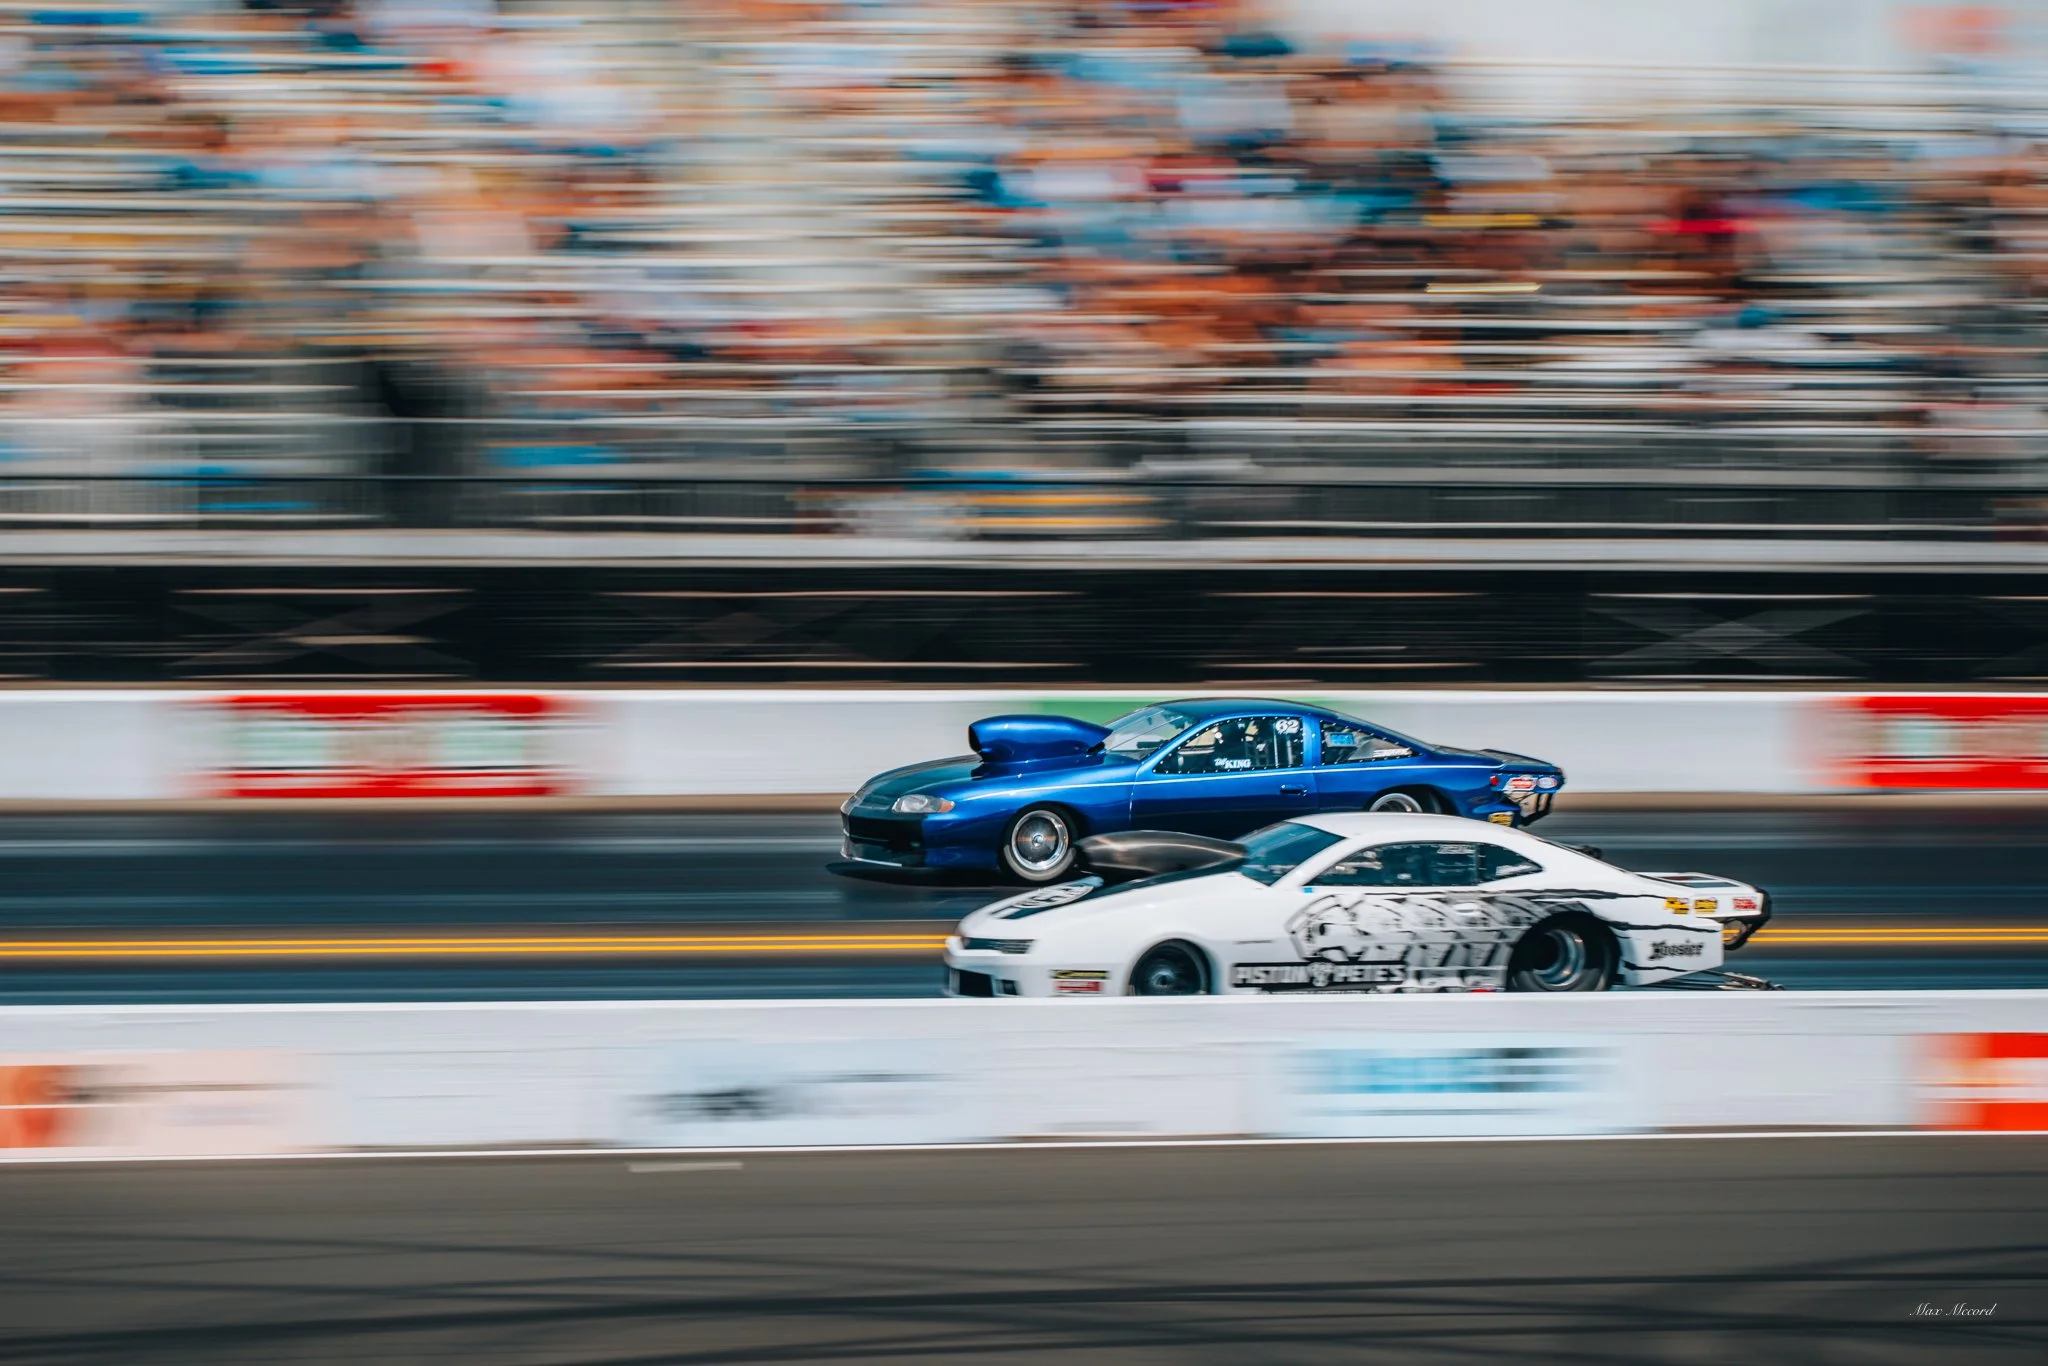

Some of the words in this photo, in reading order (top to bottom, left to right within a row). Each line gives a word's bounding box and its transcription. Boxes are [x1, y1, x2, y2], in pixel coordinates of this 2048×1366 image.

[1275, 719, 1299, 734] 62
[1225, 759, 1251, 769] KING
[1648, 939, 1704, 960] Hoosier
